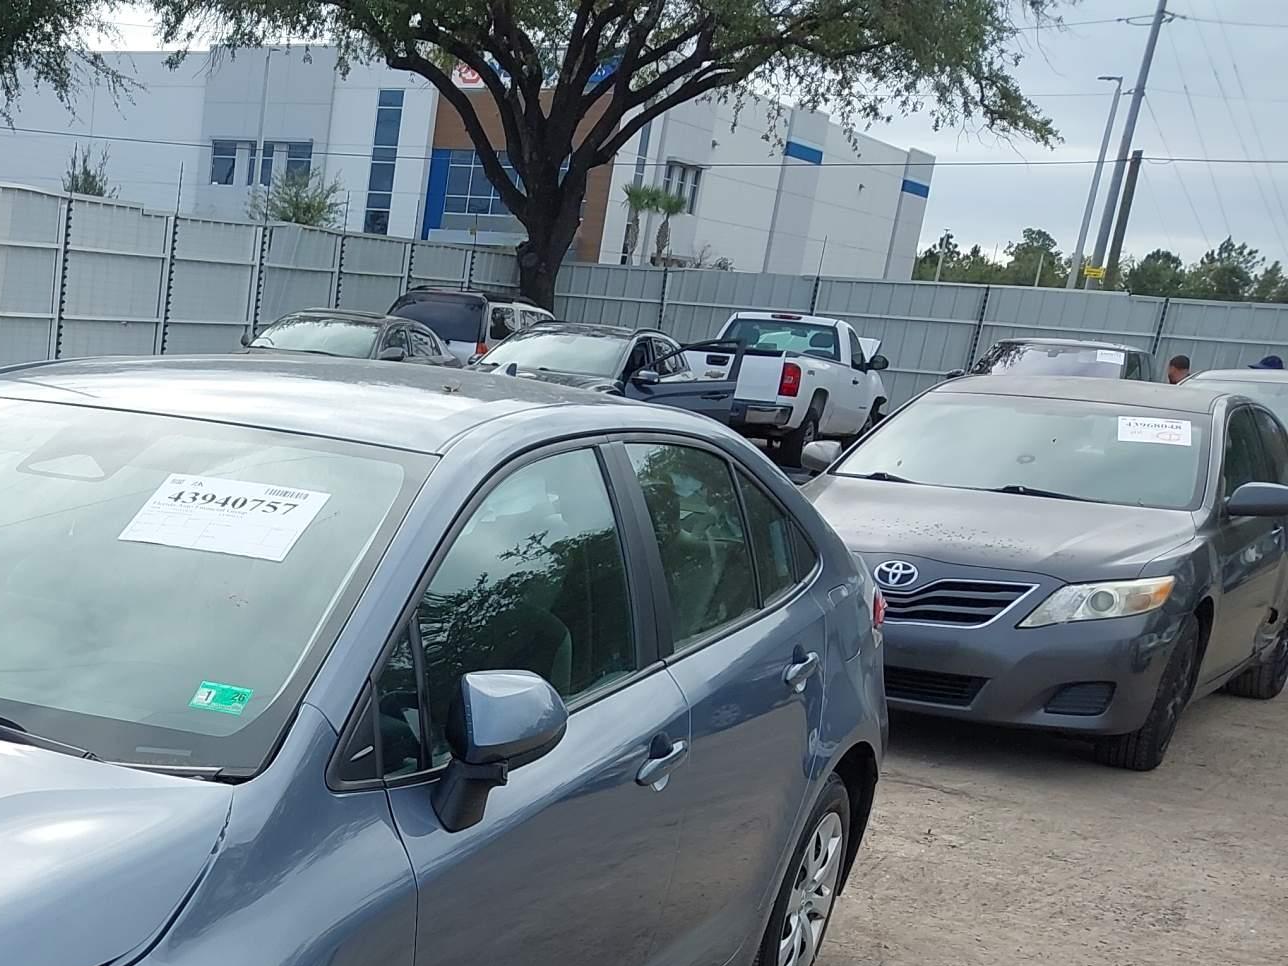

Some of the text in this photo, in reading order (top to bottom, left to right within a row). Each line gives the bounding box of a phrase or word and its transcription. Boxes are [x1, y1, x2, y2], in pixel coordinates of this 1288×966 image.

[167, 489, 299, 516] 43940757
[204, 690, 212, 702] 1
[231, 692, 247, 703] 26
